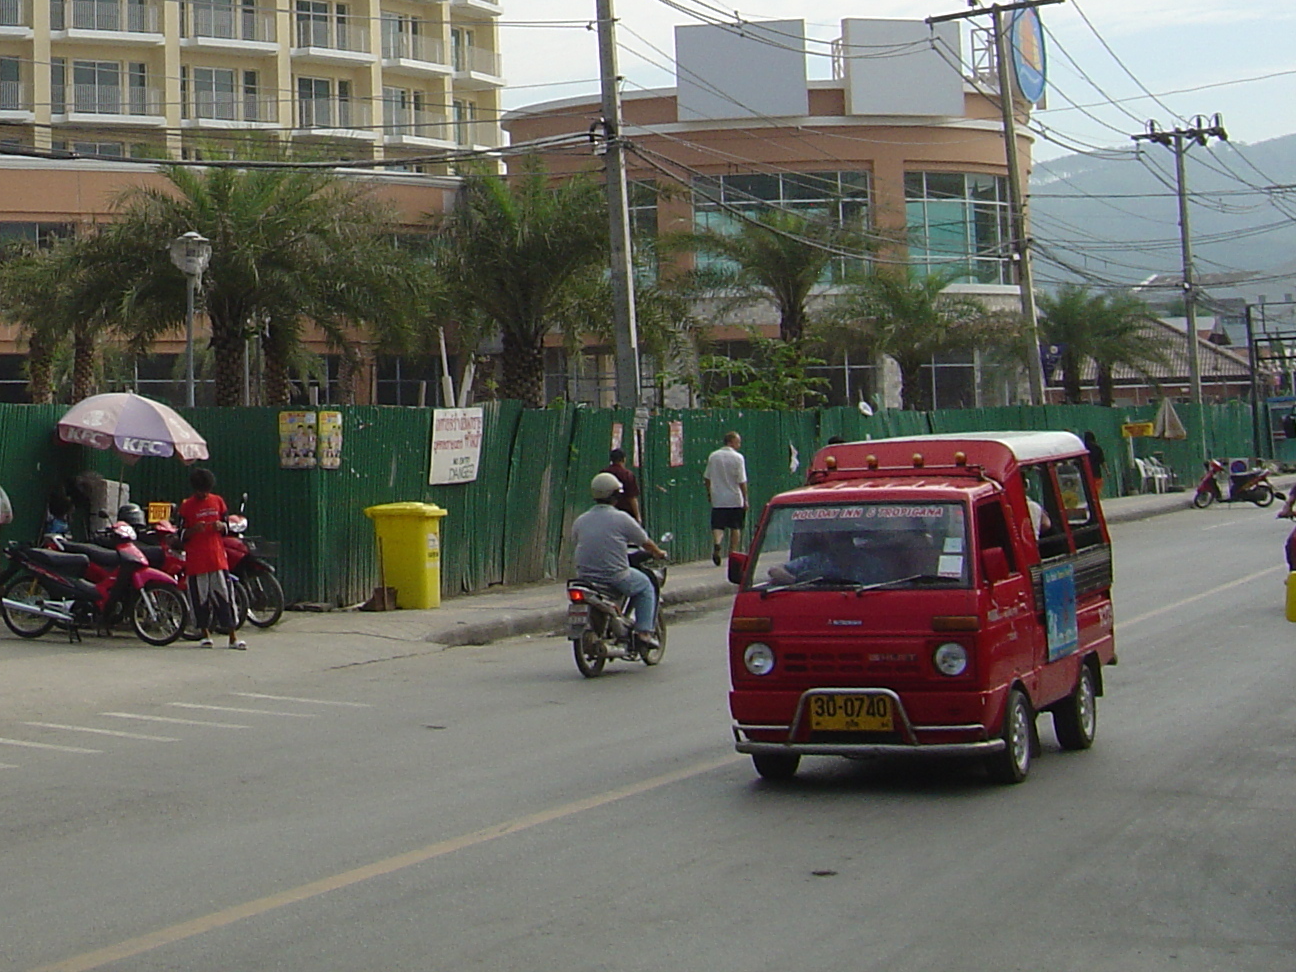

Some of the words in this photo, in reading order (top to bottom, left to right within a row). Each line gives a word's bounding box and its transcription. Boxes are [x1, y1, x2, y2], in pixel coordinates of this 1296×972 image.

[67, 427, 104, 447] KFC
[122, 437, 167, 455] KFC
[791, 508, 840, 520] HOLIDAY
[840, 508, 863, 518] INN
[814, 697, 888, 718] 30-0740
